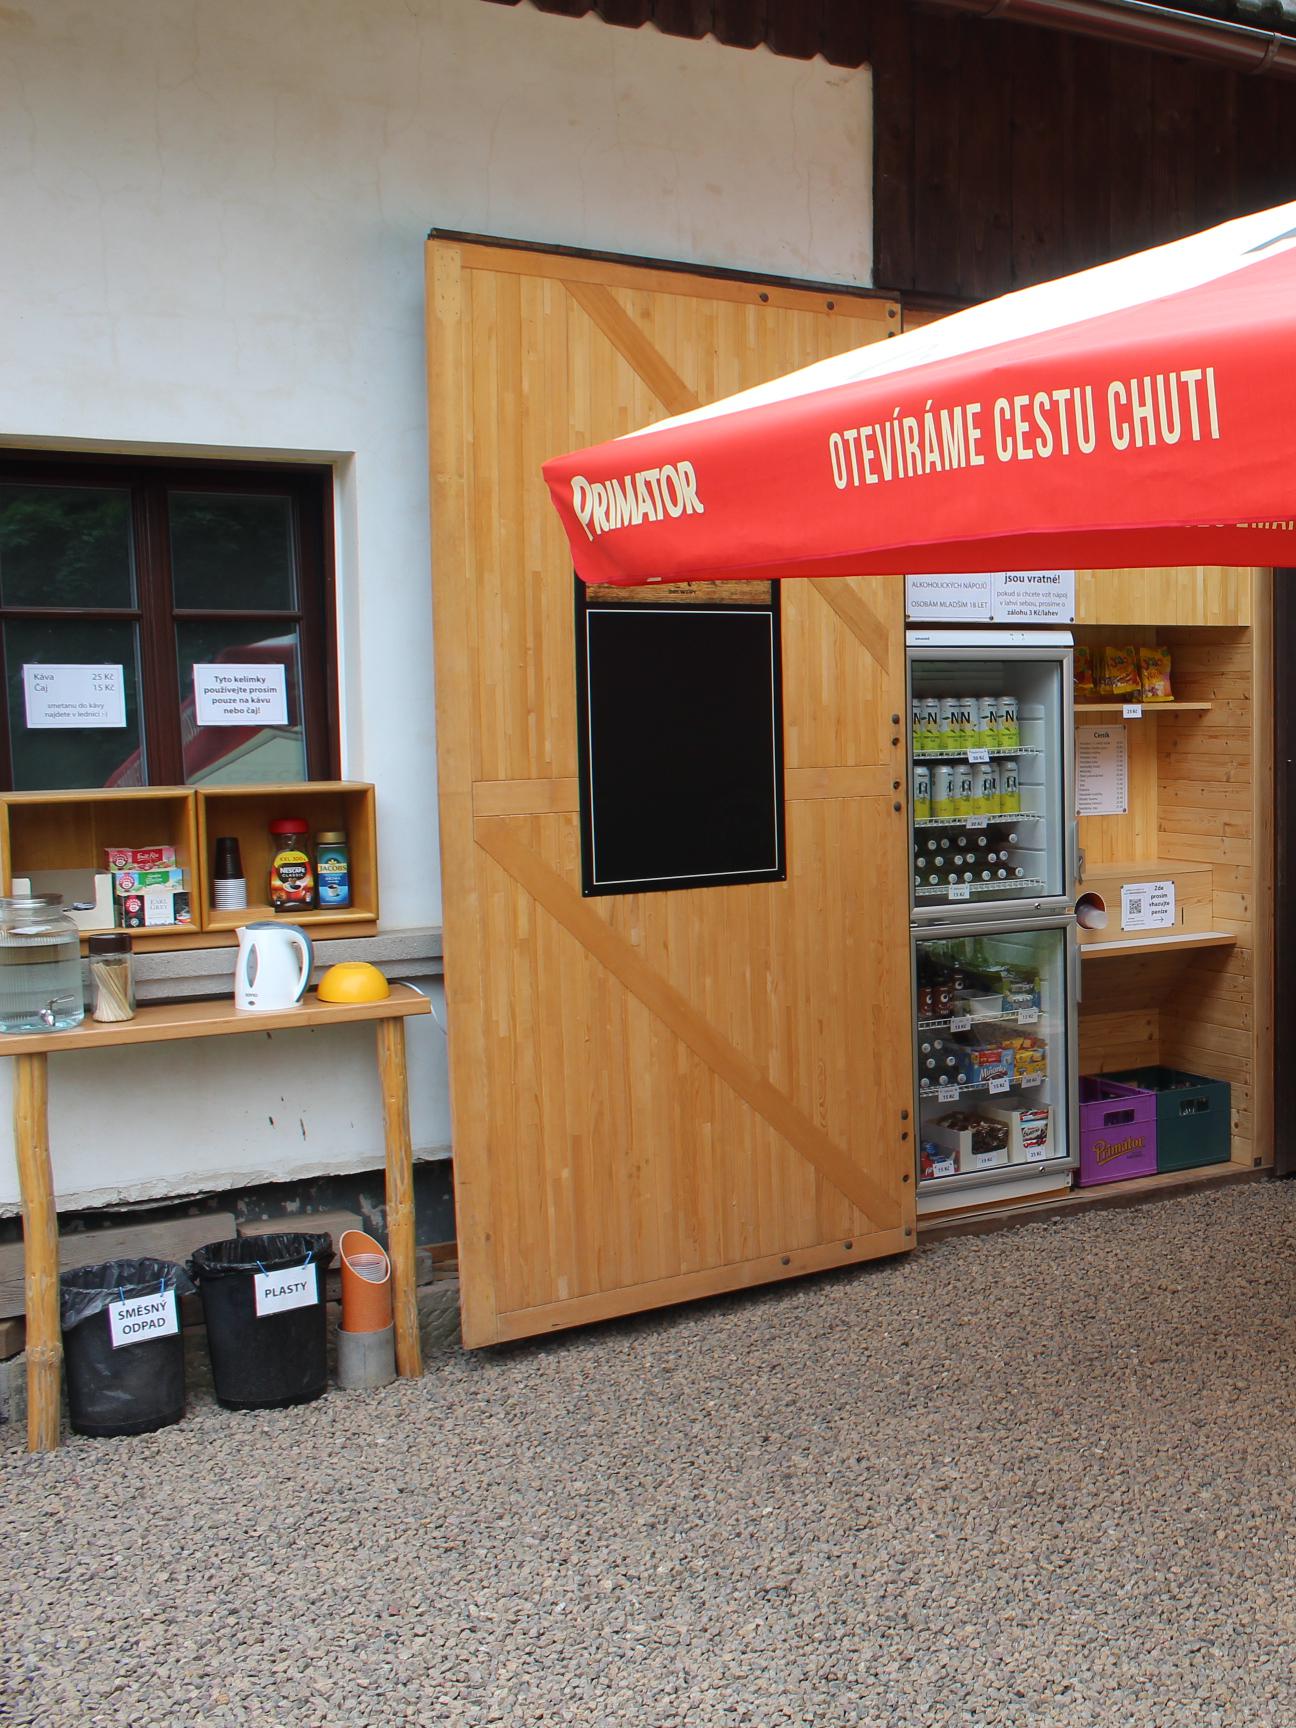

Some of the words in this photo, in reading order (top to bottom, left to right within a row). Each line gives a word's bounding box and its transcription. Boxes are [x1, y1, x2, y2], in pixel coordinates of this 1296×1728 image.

[829, 399, 985, 490] OTEVÍRÁME
[994, 385, 1096, 462] CESTU
[1107, 367, 1220, 451] CHUTI
[1004, 572, 1025, 585] jsou
[1027, 574, 1060, 584] vratné!
[912, 581, 962, 589] ALKOHOLICKÝCH
[996, 590, 1016, 598] pokud
[911, 600, 938, 608] OSOBÁM
[977, 601, 988, 609] LET
[1033, 609, 1059, 617] Kč/lahev
[33, 672, 54, 681] Káva
[92, 673, 102, 681] 25
[104, 672, 114, 681] Kč
[214, 675, 233, 684] Tyto
[234, 675, 266, 684] kelímky
[34, 682, 48, 693] Čaj
[105, 683, 115, 691] Kč
[204, 686, 248, 695] používejte
[249, 686, 277, 695] prosím
[212, 697, 237, 705] pouze
[89, 702, 104, 710] kávy
[223, 706, 245, 714] nebo
[45, 711, 70, 719] najdete
[264, 1280, 308, 1299] PLASTY
[117, 1300, 168, 1321] SMĚSNÝ
[122, 1317, 166, 1336] ODPAD
